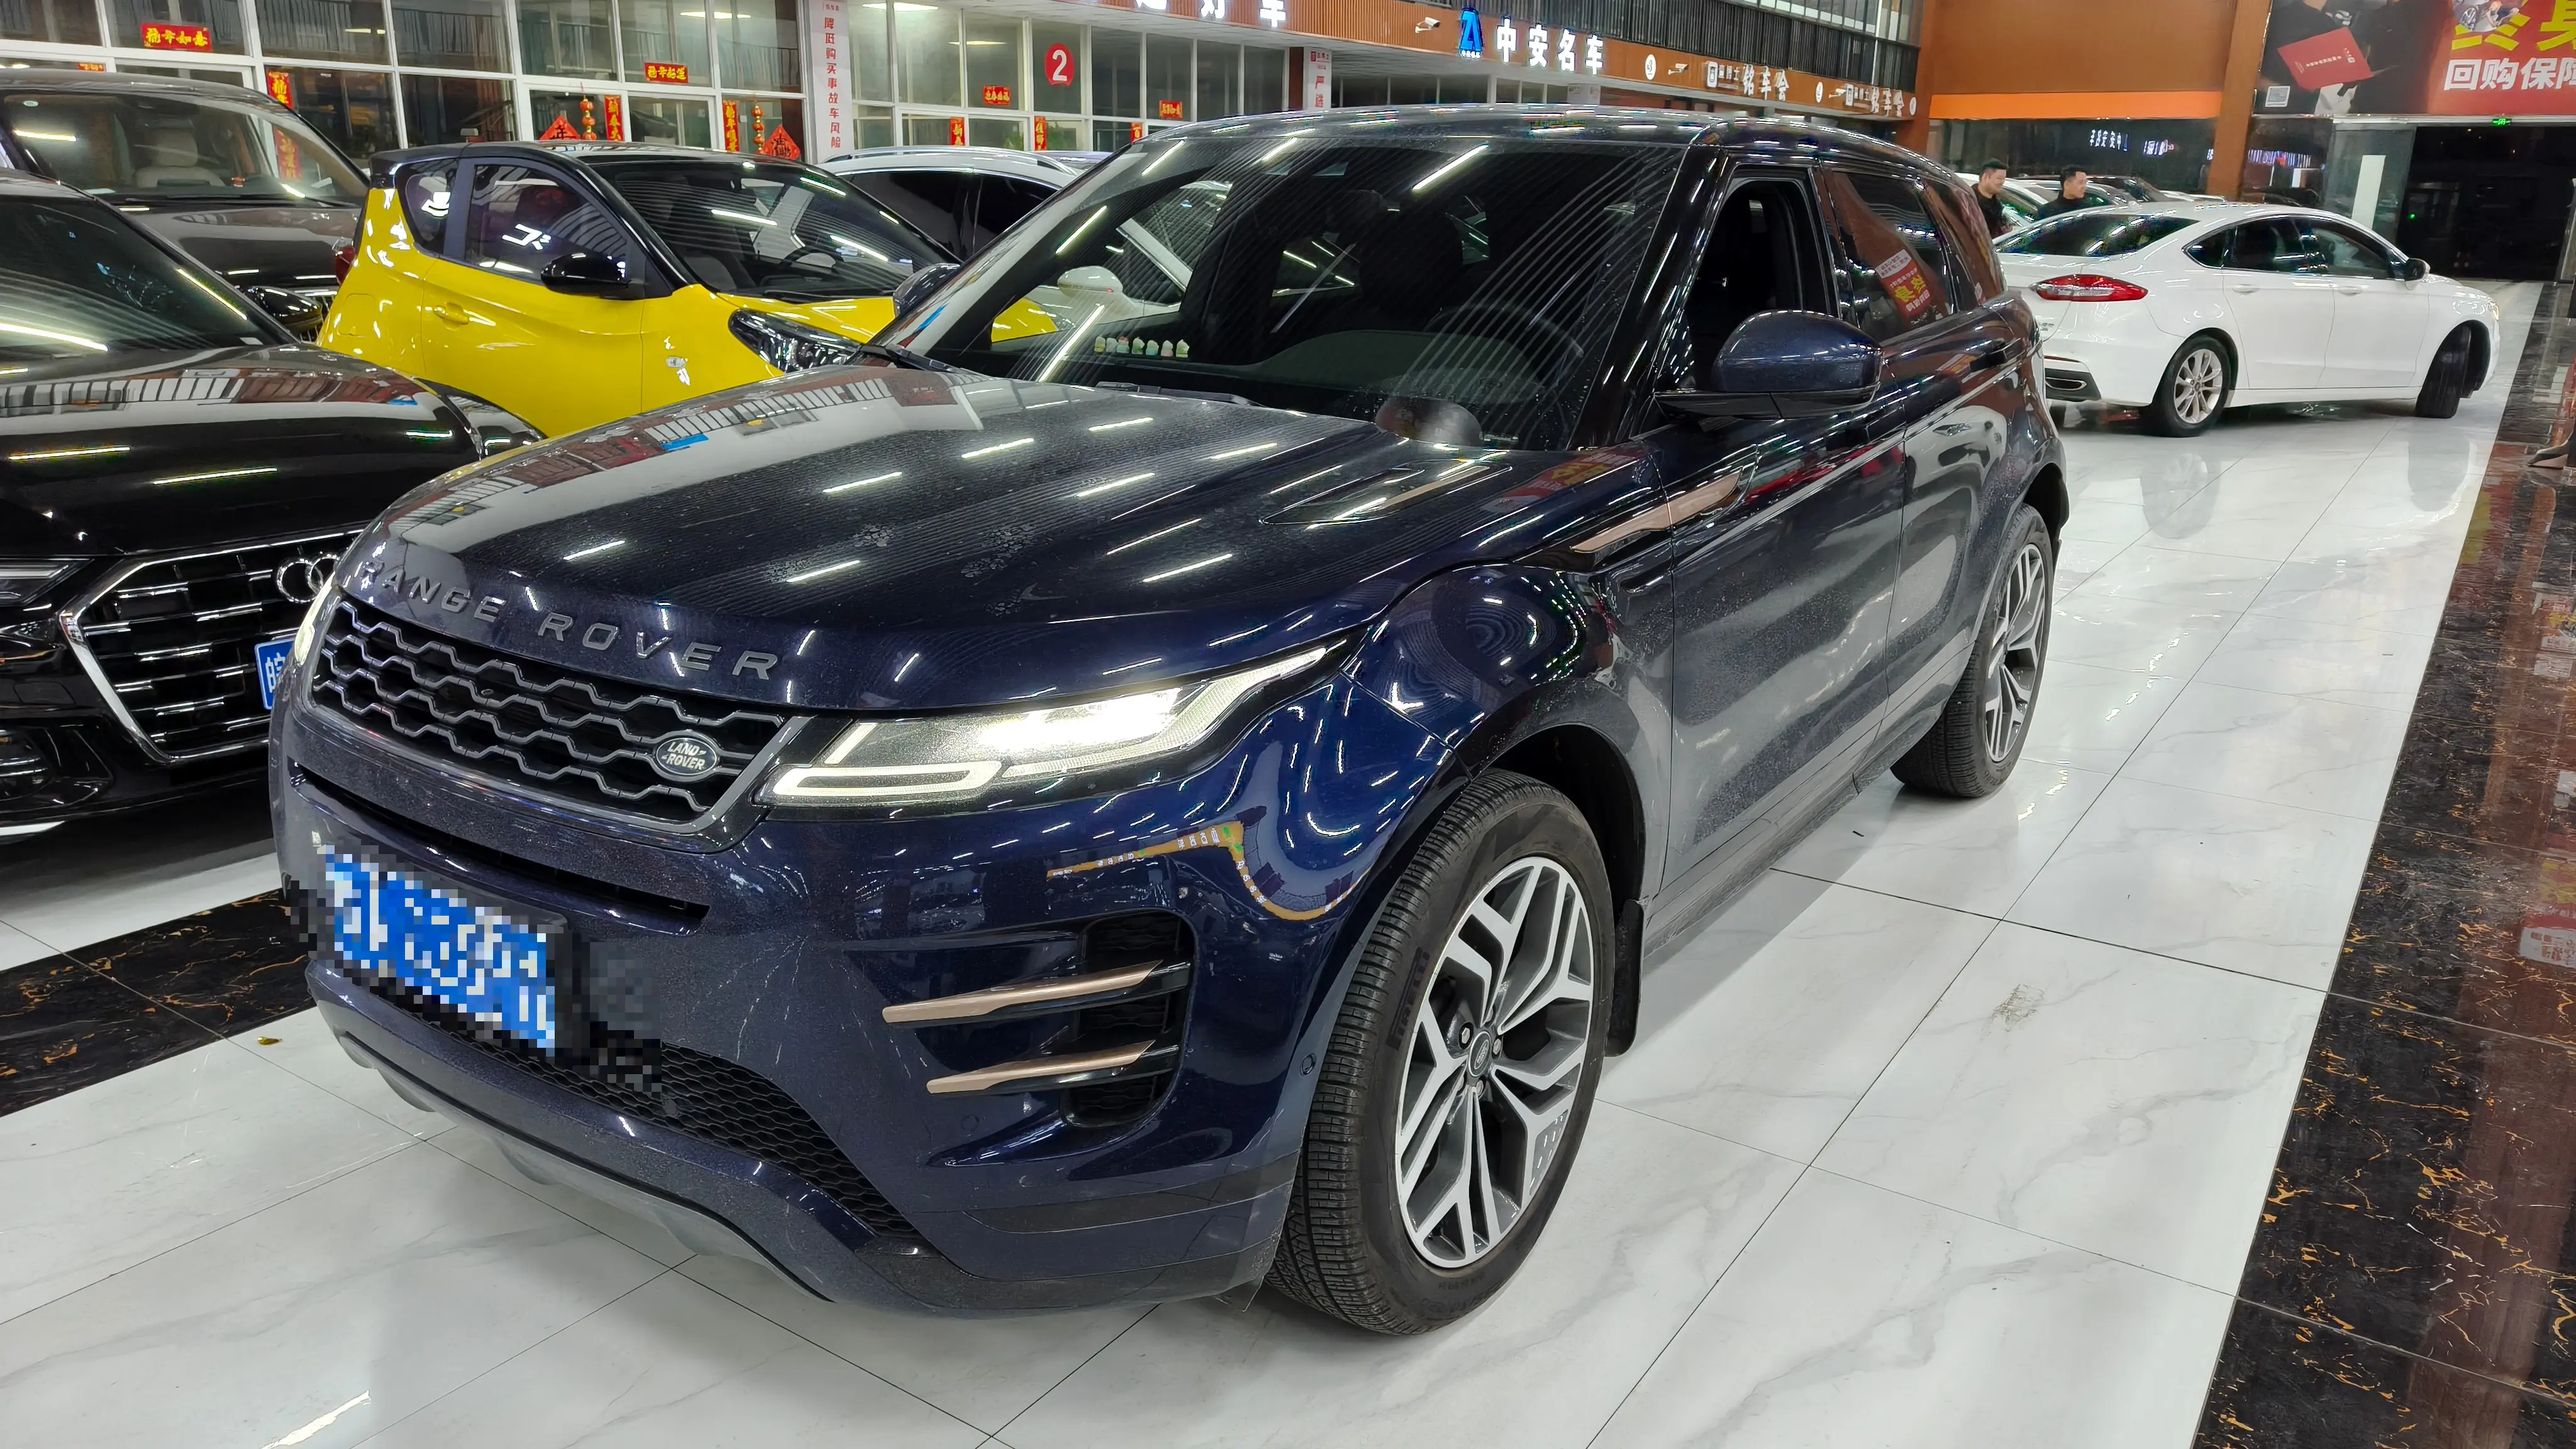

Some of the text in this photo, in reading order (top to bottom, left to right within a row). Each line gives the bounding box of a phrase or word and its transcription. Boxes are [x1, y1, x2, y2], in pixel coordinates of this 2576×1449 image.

[1052, 49, 1068, 82] 2
[1497, 17, 1603, 75] 中安名车
[824, 17, 841, 148] 降低购买事故车风险
[361, 558, 778, 680] RANGE ROVER
[666, 753, 706, 770] ROVER
[667, 741, 701, 756] LAND
